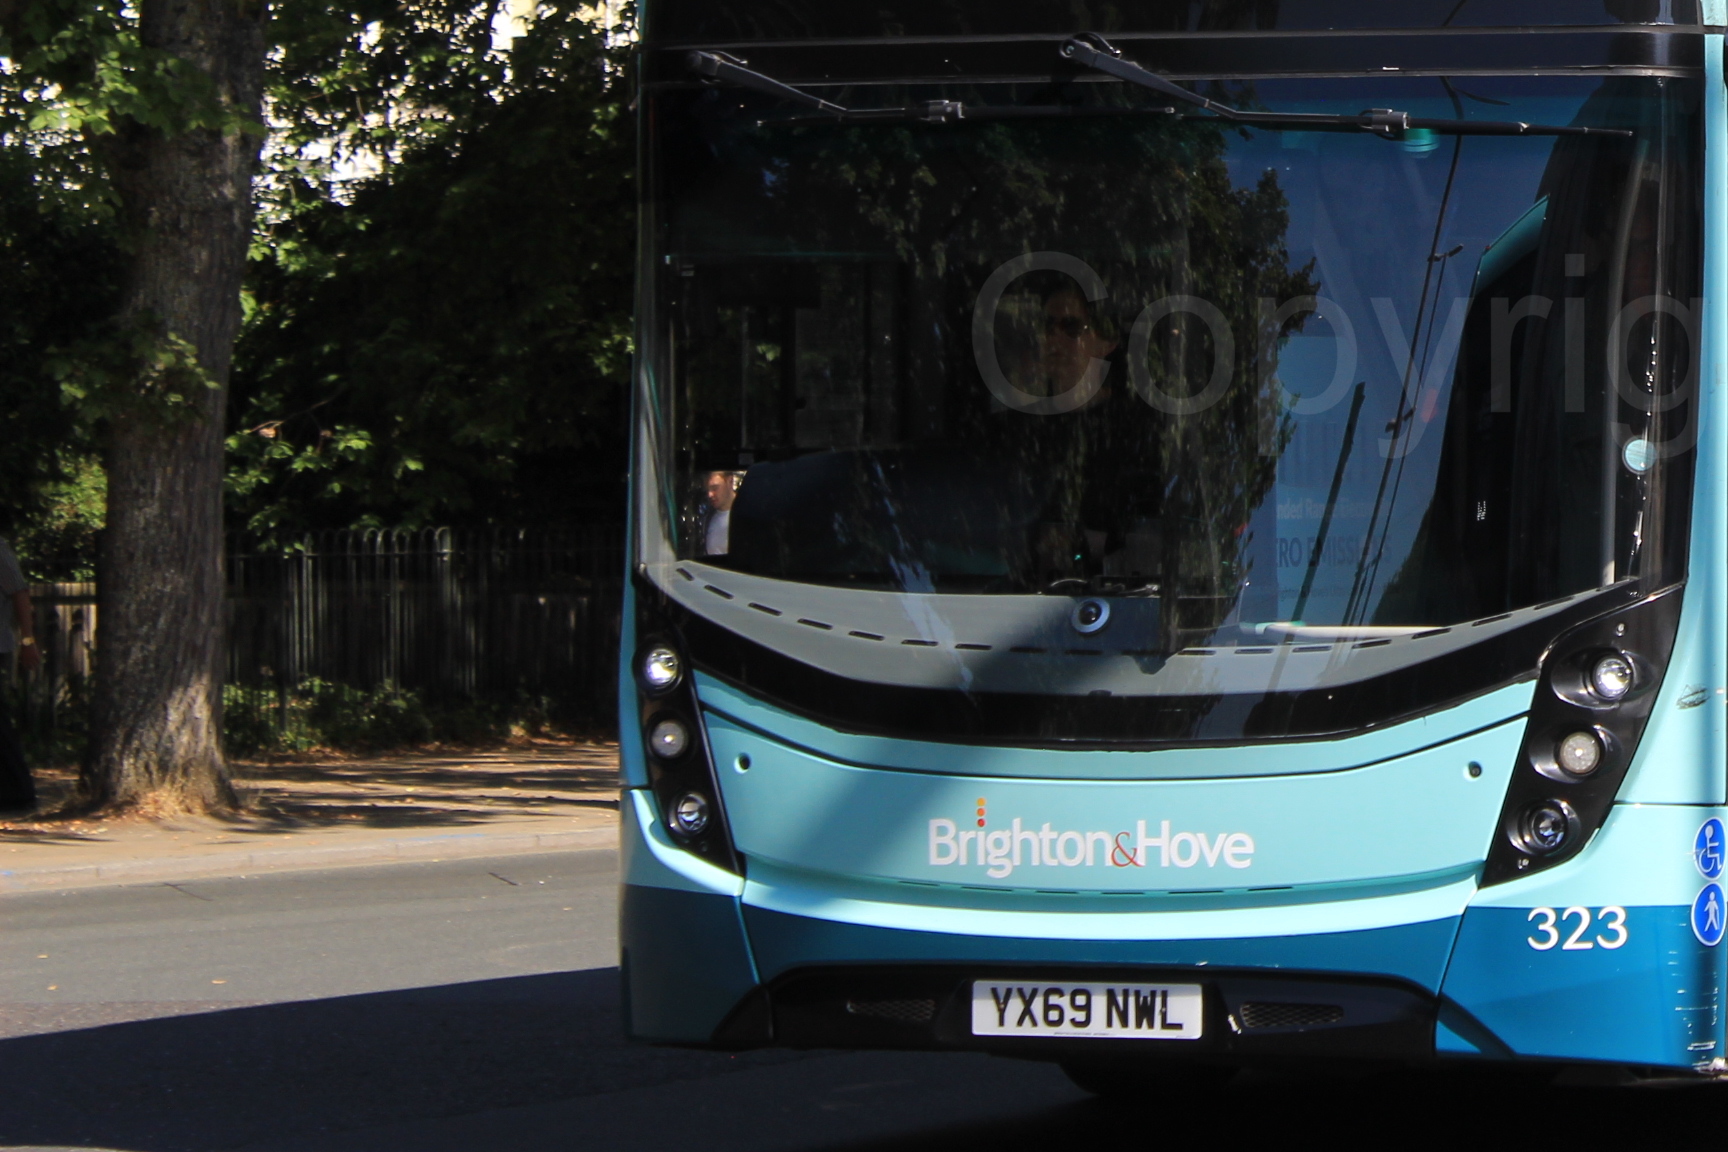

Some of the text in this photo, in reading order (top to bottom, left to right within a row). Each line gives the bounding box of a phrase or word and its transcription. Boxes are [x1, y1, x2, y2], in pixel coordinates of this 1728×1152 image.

[928, 797, 1255, 879] Brighton&Hove
[1526, 906, 1629, 951] 323
[990, 987, 1184, 1031] YX69 NWL
